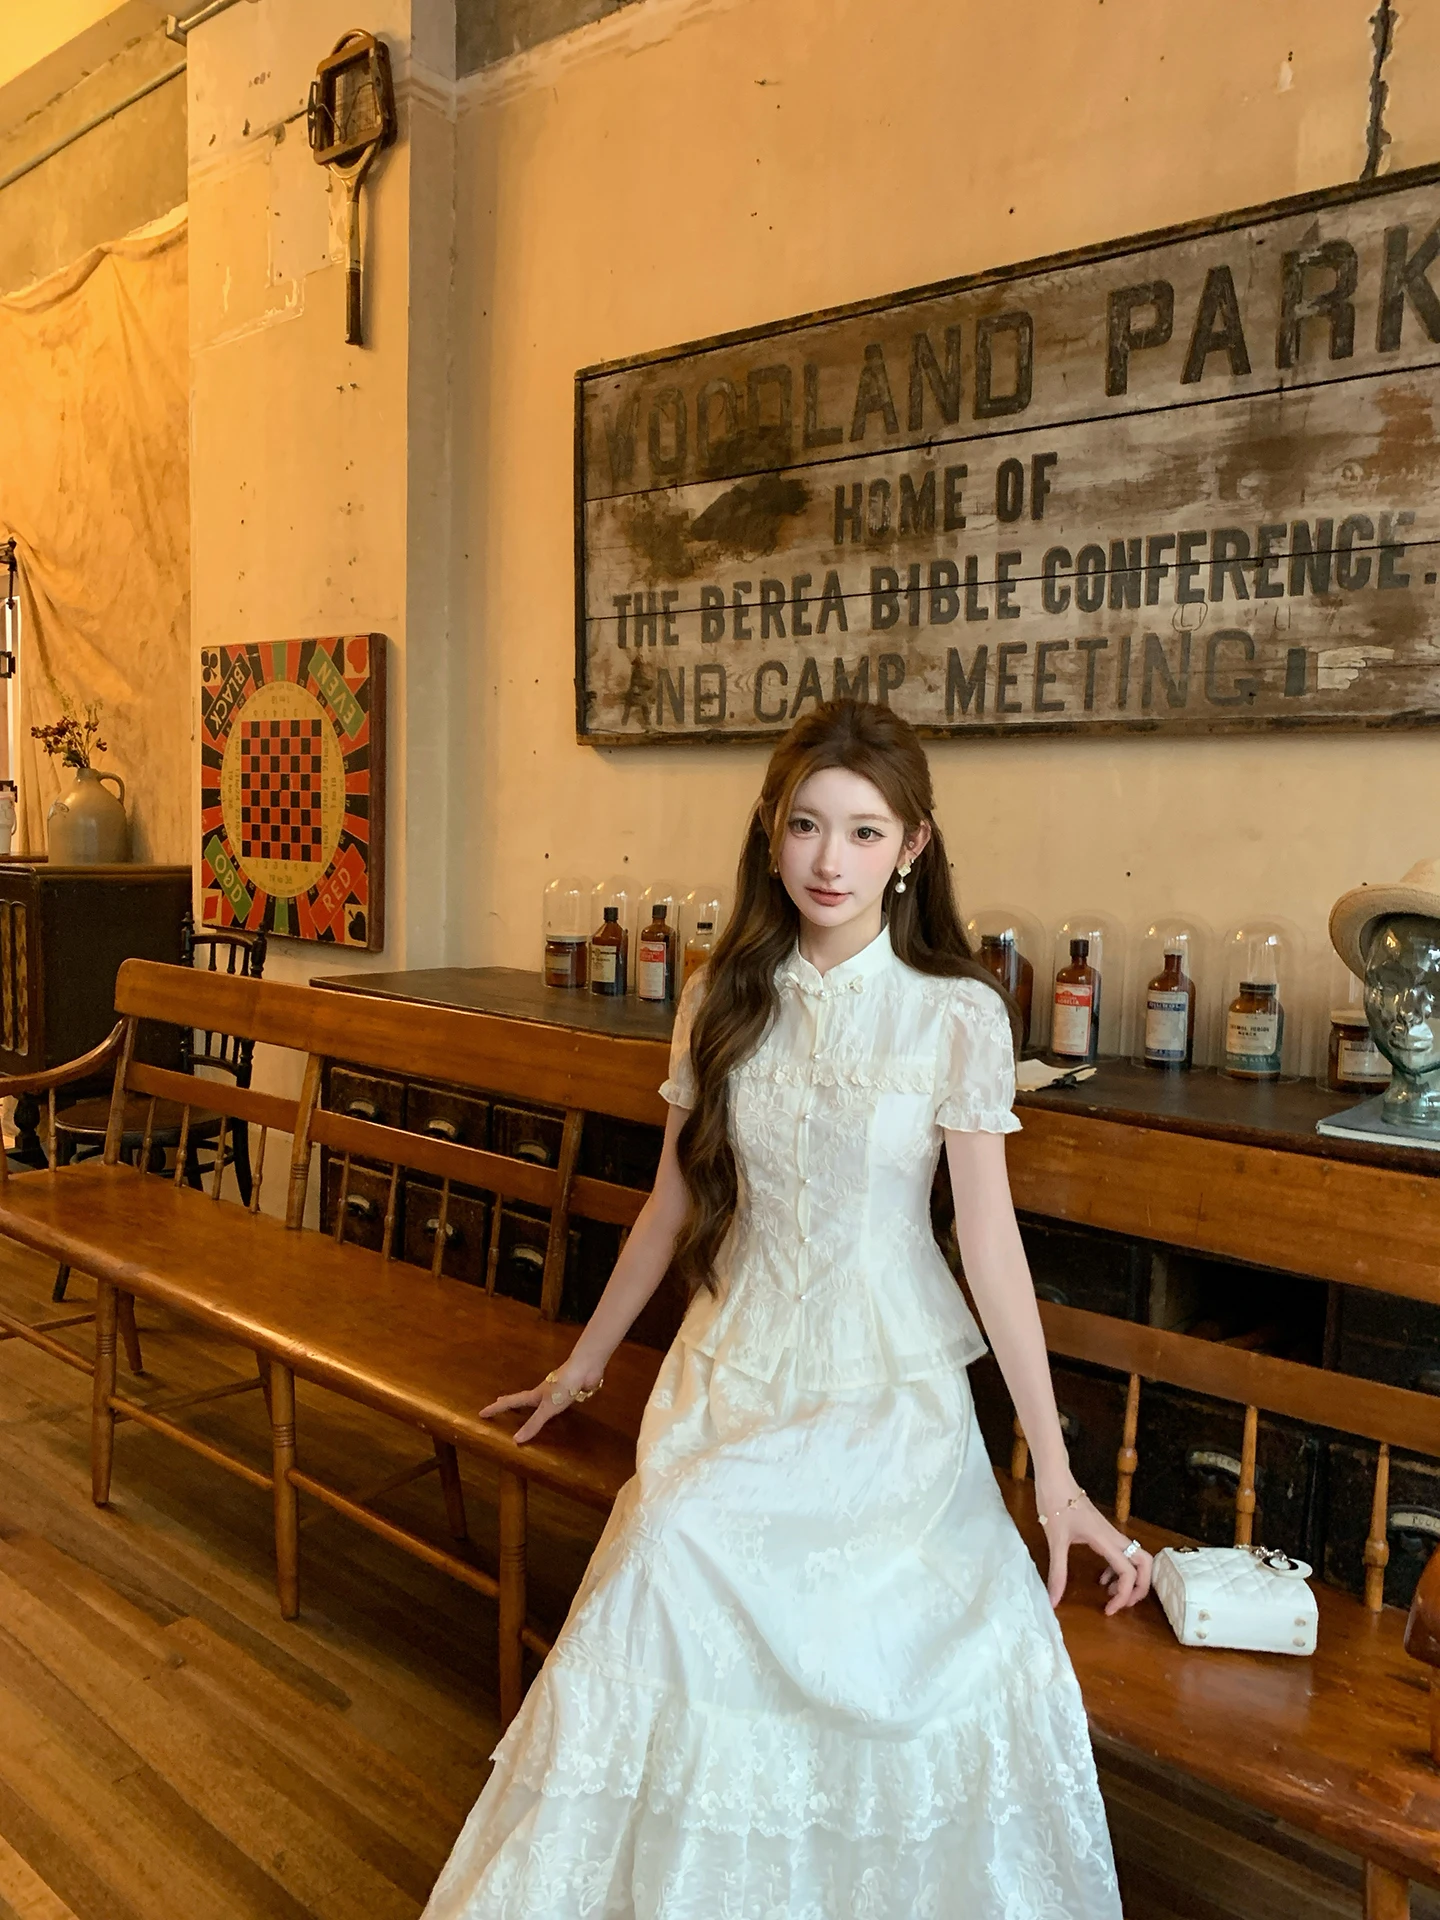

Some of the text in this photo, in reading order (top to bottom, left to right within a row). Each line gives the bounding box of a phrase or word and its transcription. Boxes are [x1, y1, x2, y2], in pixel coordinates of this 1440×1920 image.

[1105, 218, 1440, 397] PARK
[833, 451, 1058, 545] HOME OF
[613, 590, 680, 649] THE
[701, 569, 848, 645] BEREA
[870, 548, 1022, 630] BIBLE
[210, 666, 245, 730] BLACK
[317, 661, 356, 725] EVEN
[754, 653, 906, 725] CAMP
[943, 629, 1257, 718] MEETING
[215, 854, 242, 903] ODD
[322, 867, 351, 913] RED
